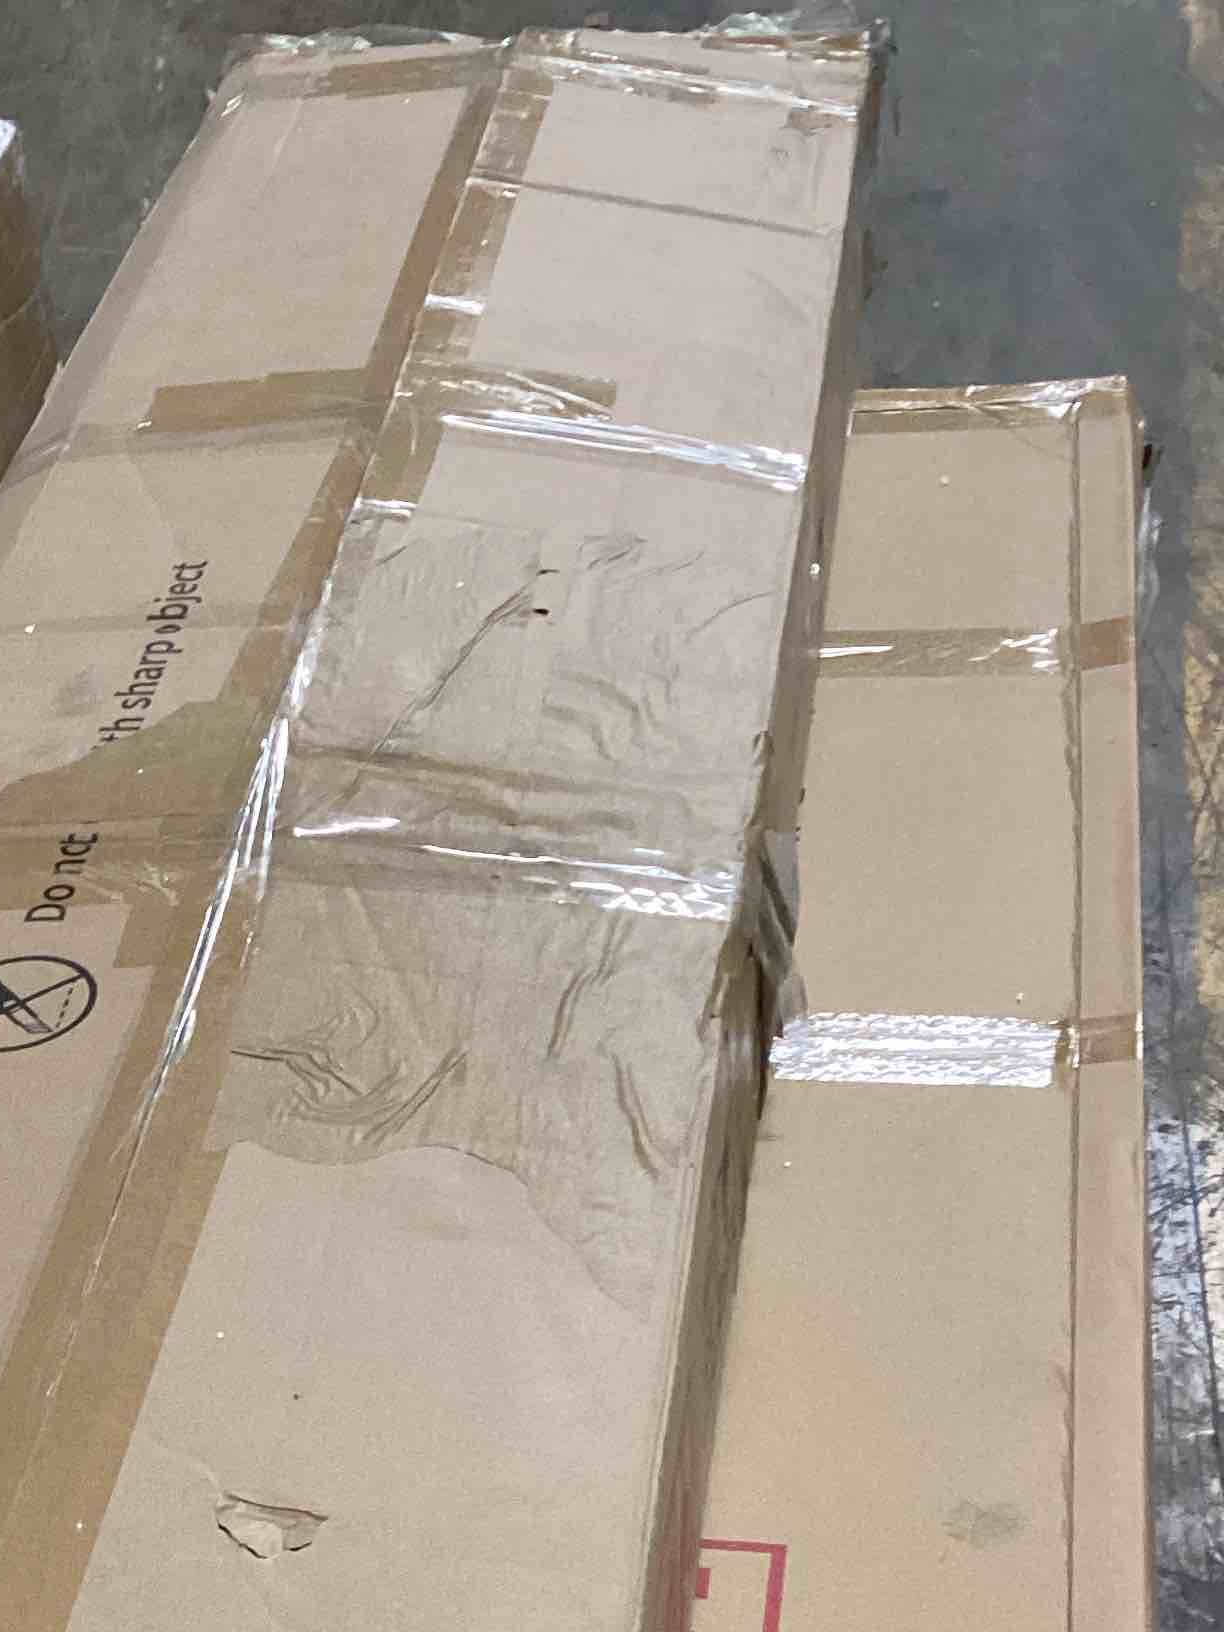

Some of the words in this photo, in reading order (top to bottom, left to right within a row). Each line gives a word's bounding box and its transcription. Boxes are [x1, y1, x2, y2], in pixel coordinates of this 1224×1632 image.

[146, 560, 209, 635] object
[114, 638, 183, 711] sharp
[24, 883, 74, 922] Do
